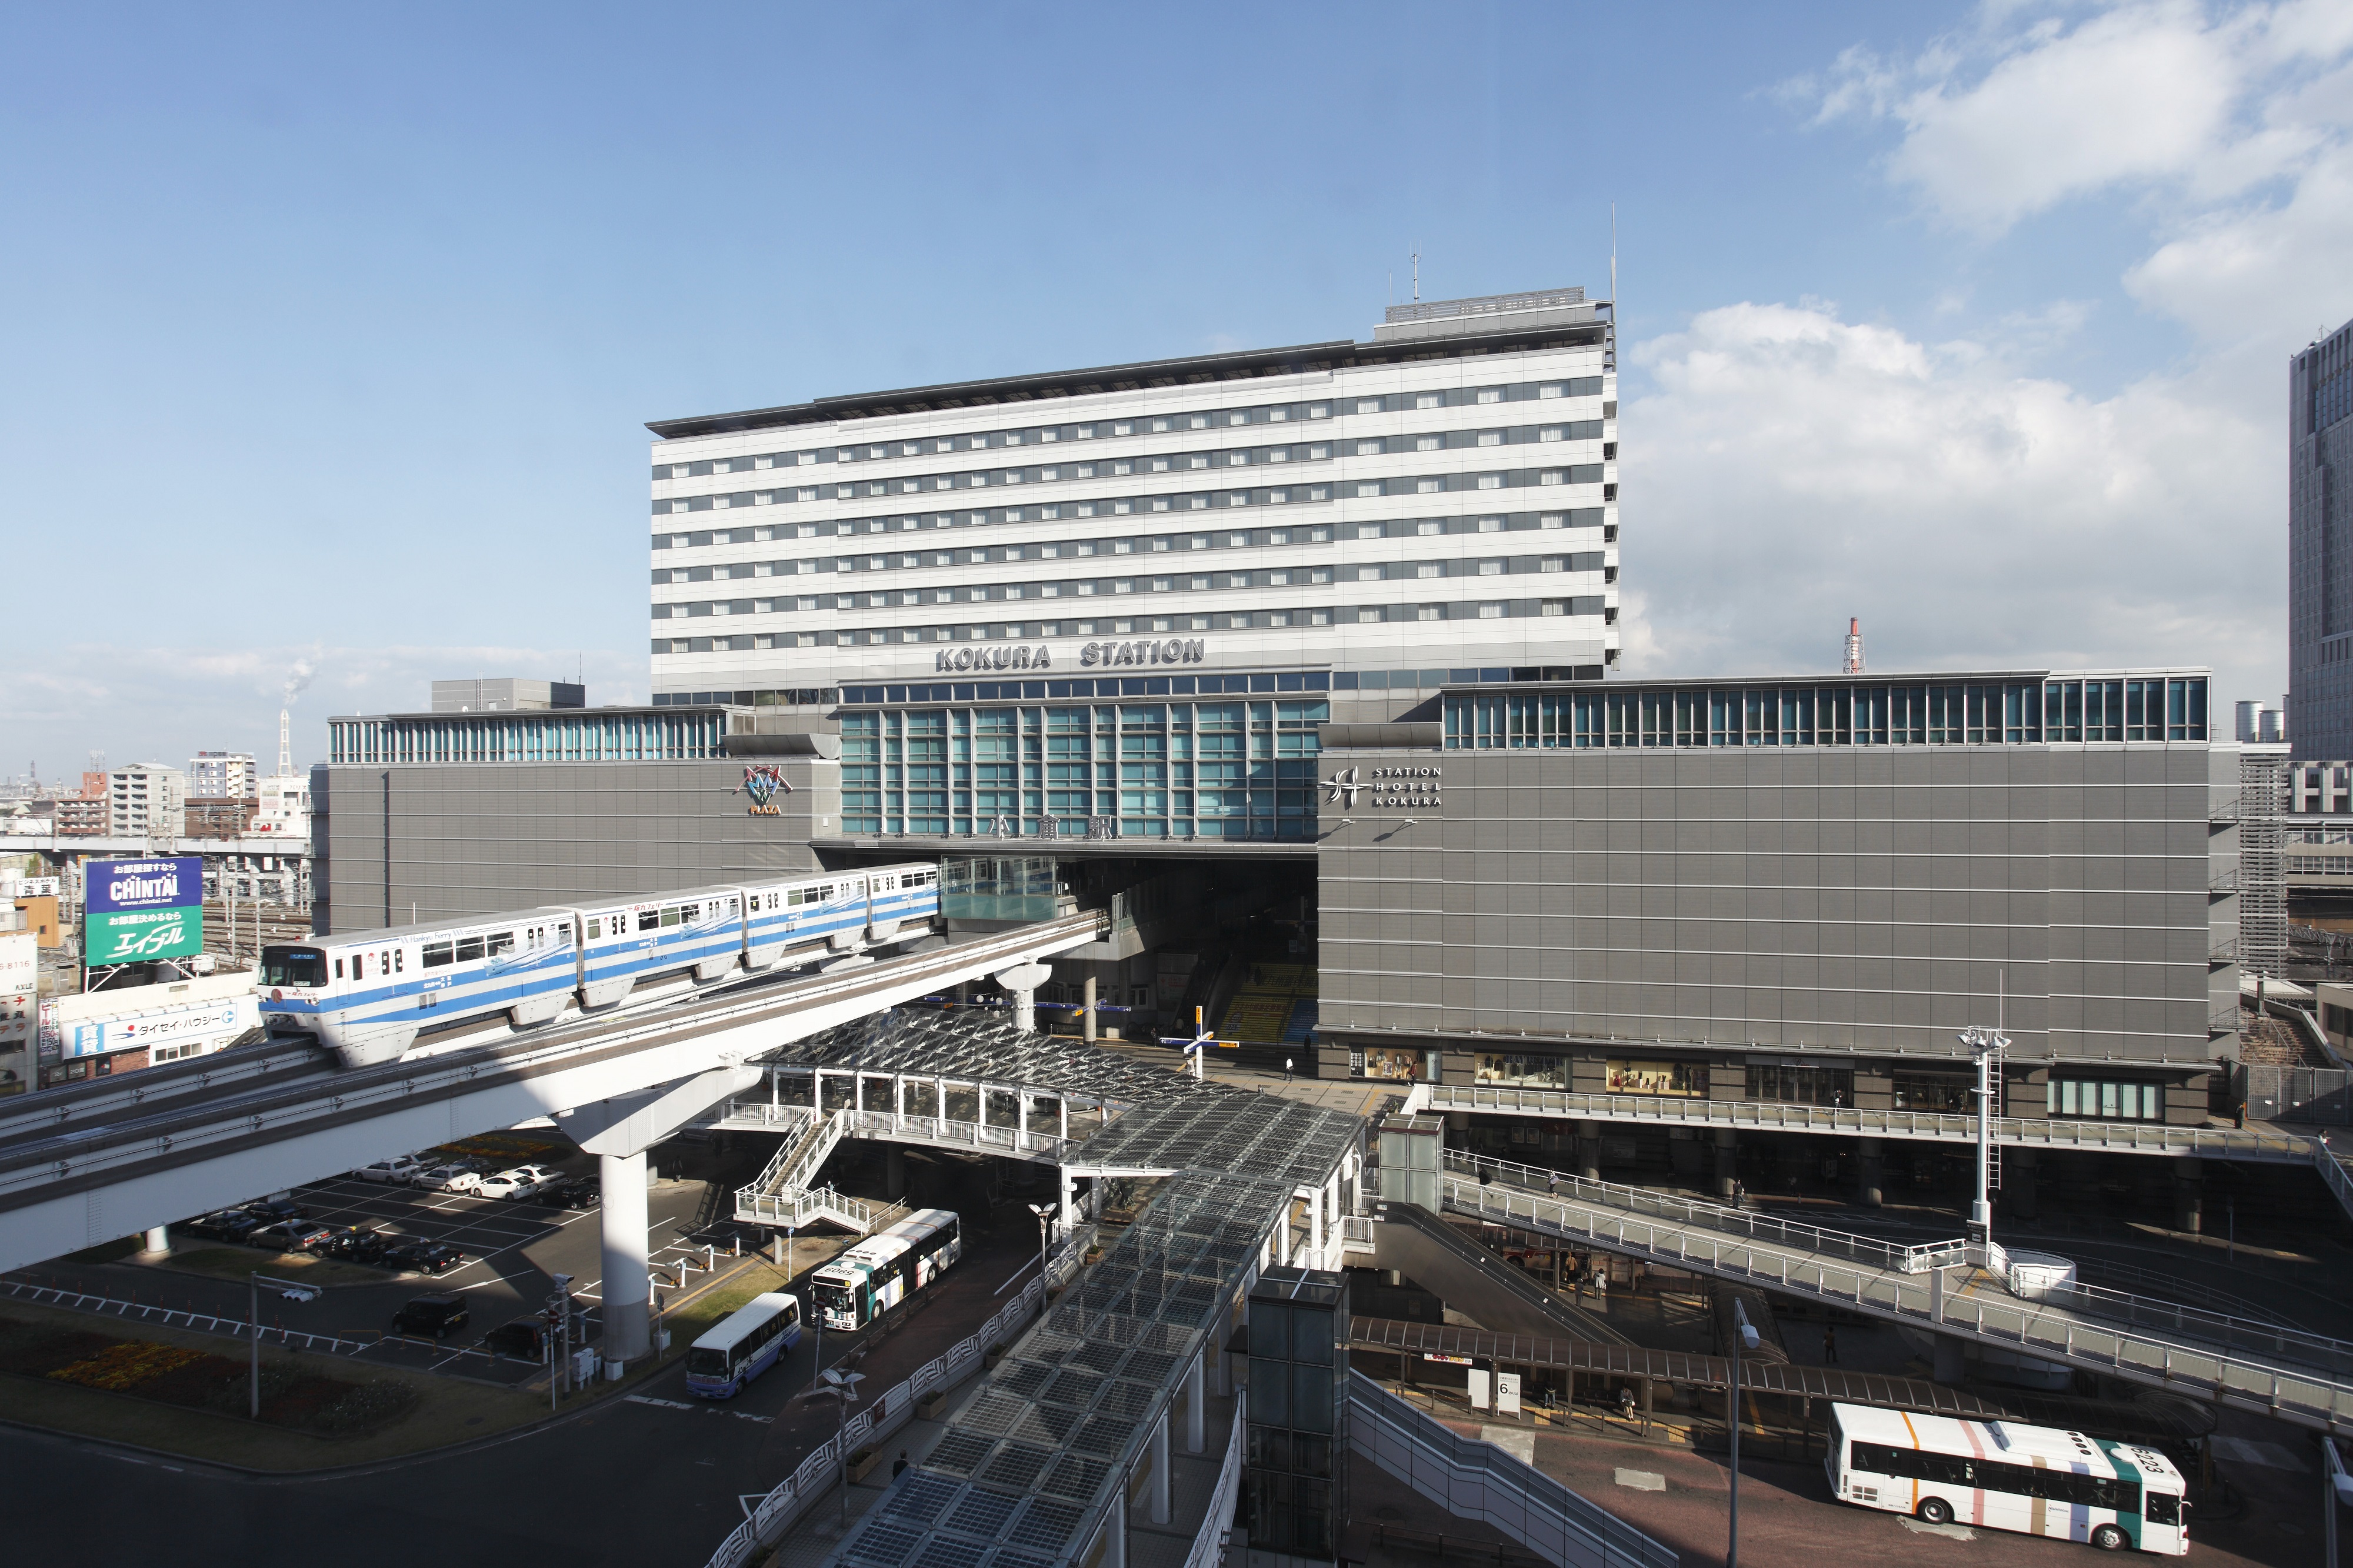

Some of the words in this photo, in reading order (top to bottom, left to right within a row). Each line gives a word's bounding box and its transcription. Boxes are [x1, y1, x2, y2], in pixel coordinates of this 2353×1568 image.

[940, 645, 1054, 669] KOKURA
[1085, 638, 1206, 663] STATION
[1376, 768, 1441, 776] STATION
[751, 805, 781, 814] PLAZA
[986, 814, 1112, 840] 小倉駅
[114, 862, 177, 874] お部屋探すなら
[24, 884, 52, 895] 青葉
[110, 873, 178, 901] CHINTAI
[119, 897, 172, 906] www.chintai.net
[109, 912, 182, 926] お部屋決めるなら
[112, 925, 185, 955] エイブル
[410, 935, 433, 943] Hankyu
[435, 932, 452, 941] Ferry
[15, 983, 34, 991] AXLE
[139, 1015, 221, 1036] タイセイ・ハウジー
[81, 1025, 99, 1055] 賃貸
[1500, 1383, 1508, 1394] 6
[2131, 1447, 2164, 1474] 6223
